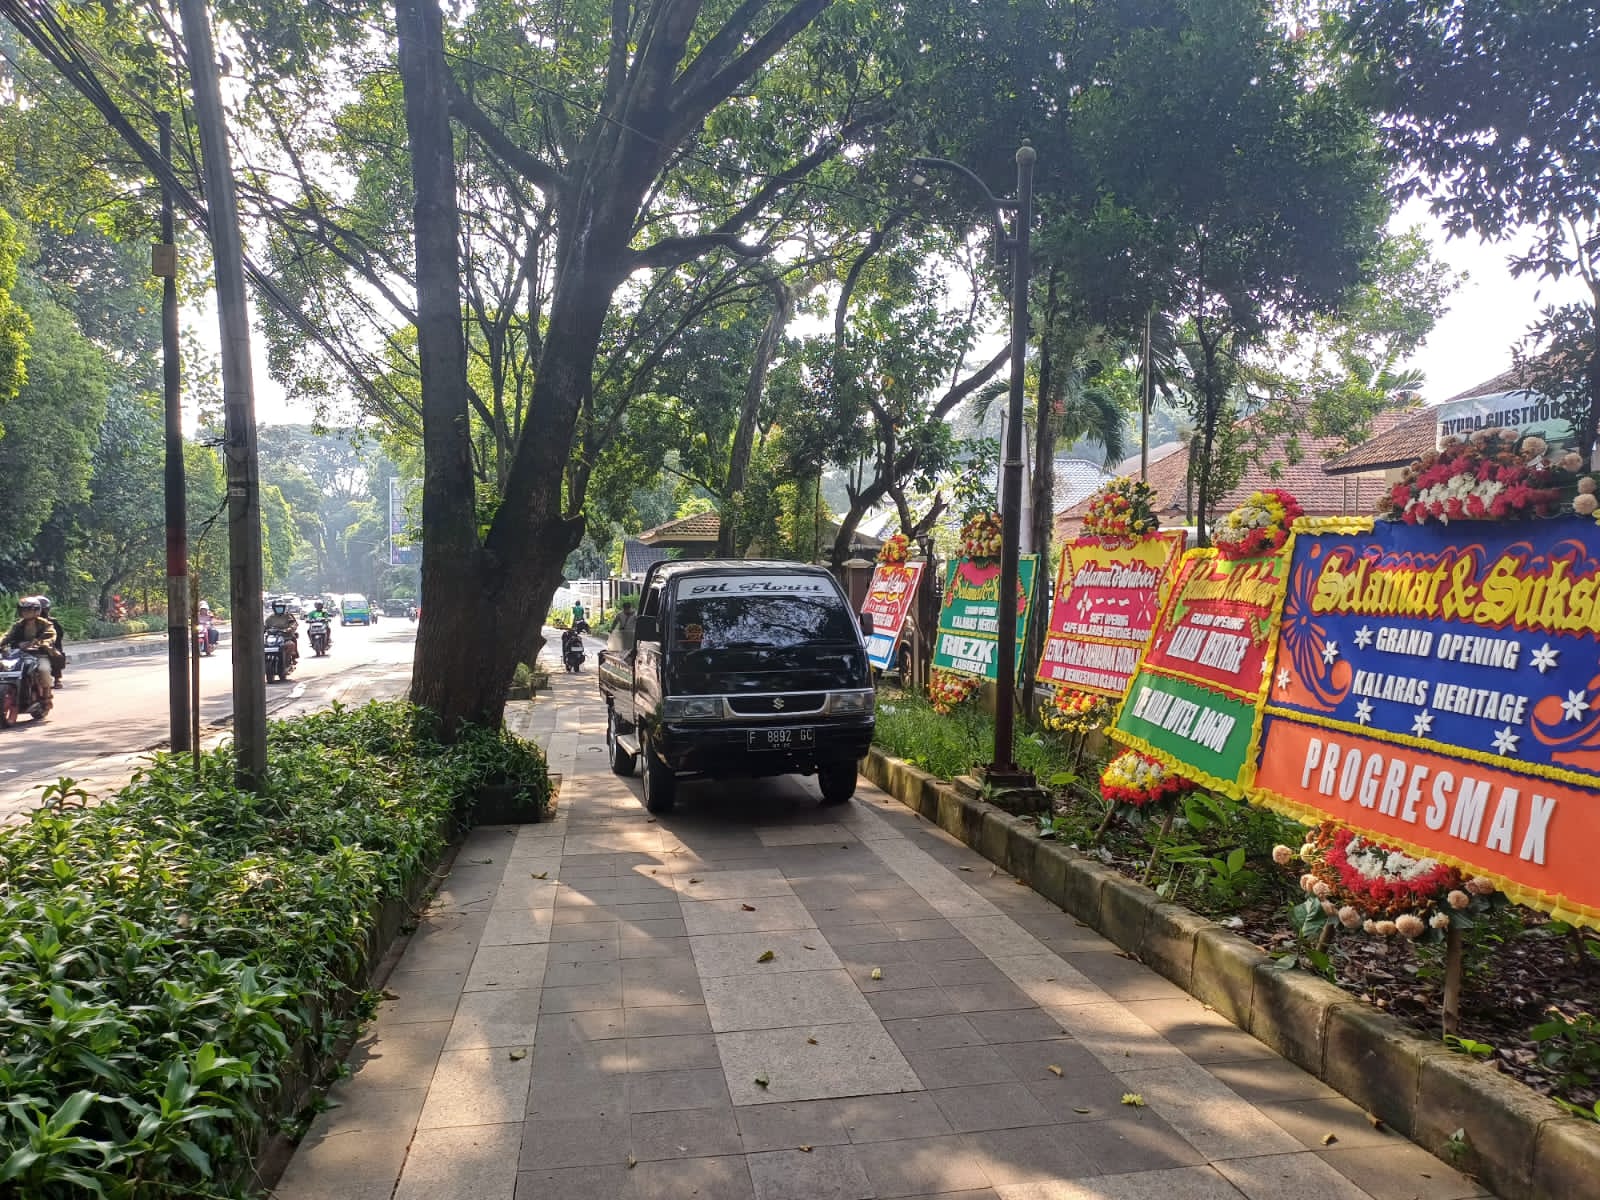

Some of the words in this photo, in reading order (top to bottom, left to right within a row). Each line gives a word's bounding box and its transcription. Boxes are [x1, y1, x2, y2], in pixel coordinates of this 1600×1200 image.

[736, 581, 819, 592] Florist
[1313, 554, 1447, 616] Selamat
[1441, 555, 1478, 620] &
[1212, 615, 1246, 631] OPENING
[1198, 630, 1251, 674] HERITAGE
[1375, 626, 1433, 657] GRAND
[1437, 633, 1521, 670] OPENING
[1352, 669, 1428, 707] KALARAS
[1432, 682, 1528, 726] HERITAGE
[748, 731, 756, 744] F
[766, 729, 794, 743] 8892
[1162, 697, 1201, 738] HOTEL
[1189, 706, 1236, 753] BOGOR
[1300, 738, 1556, 866] PROGRESMAX
